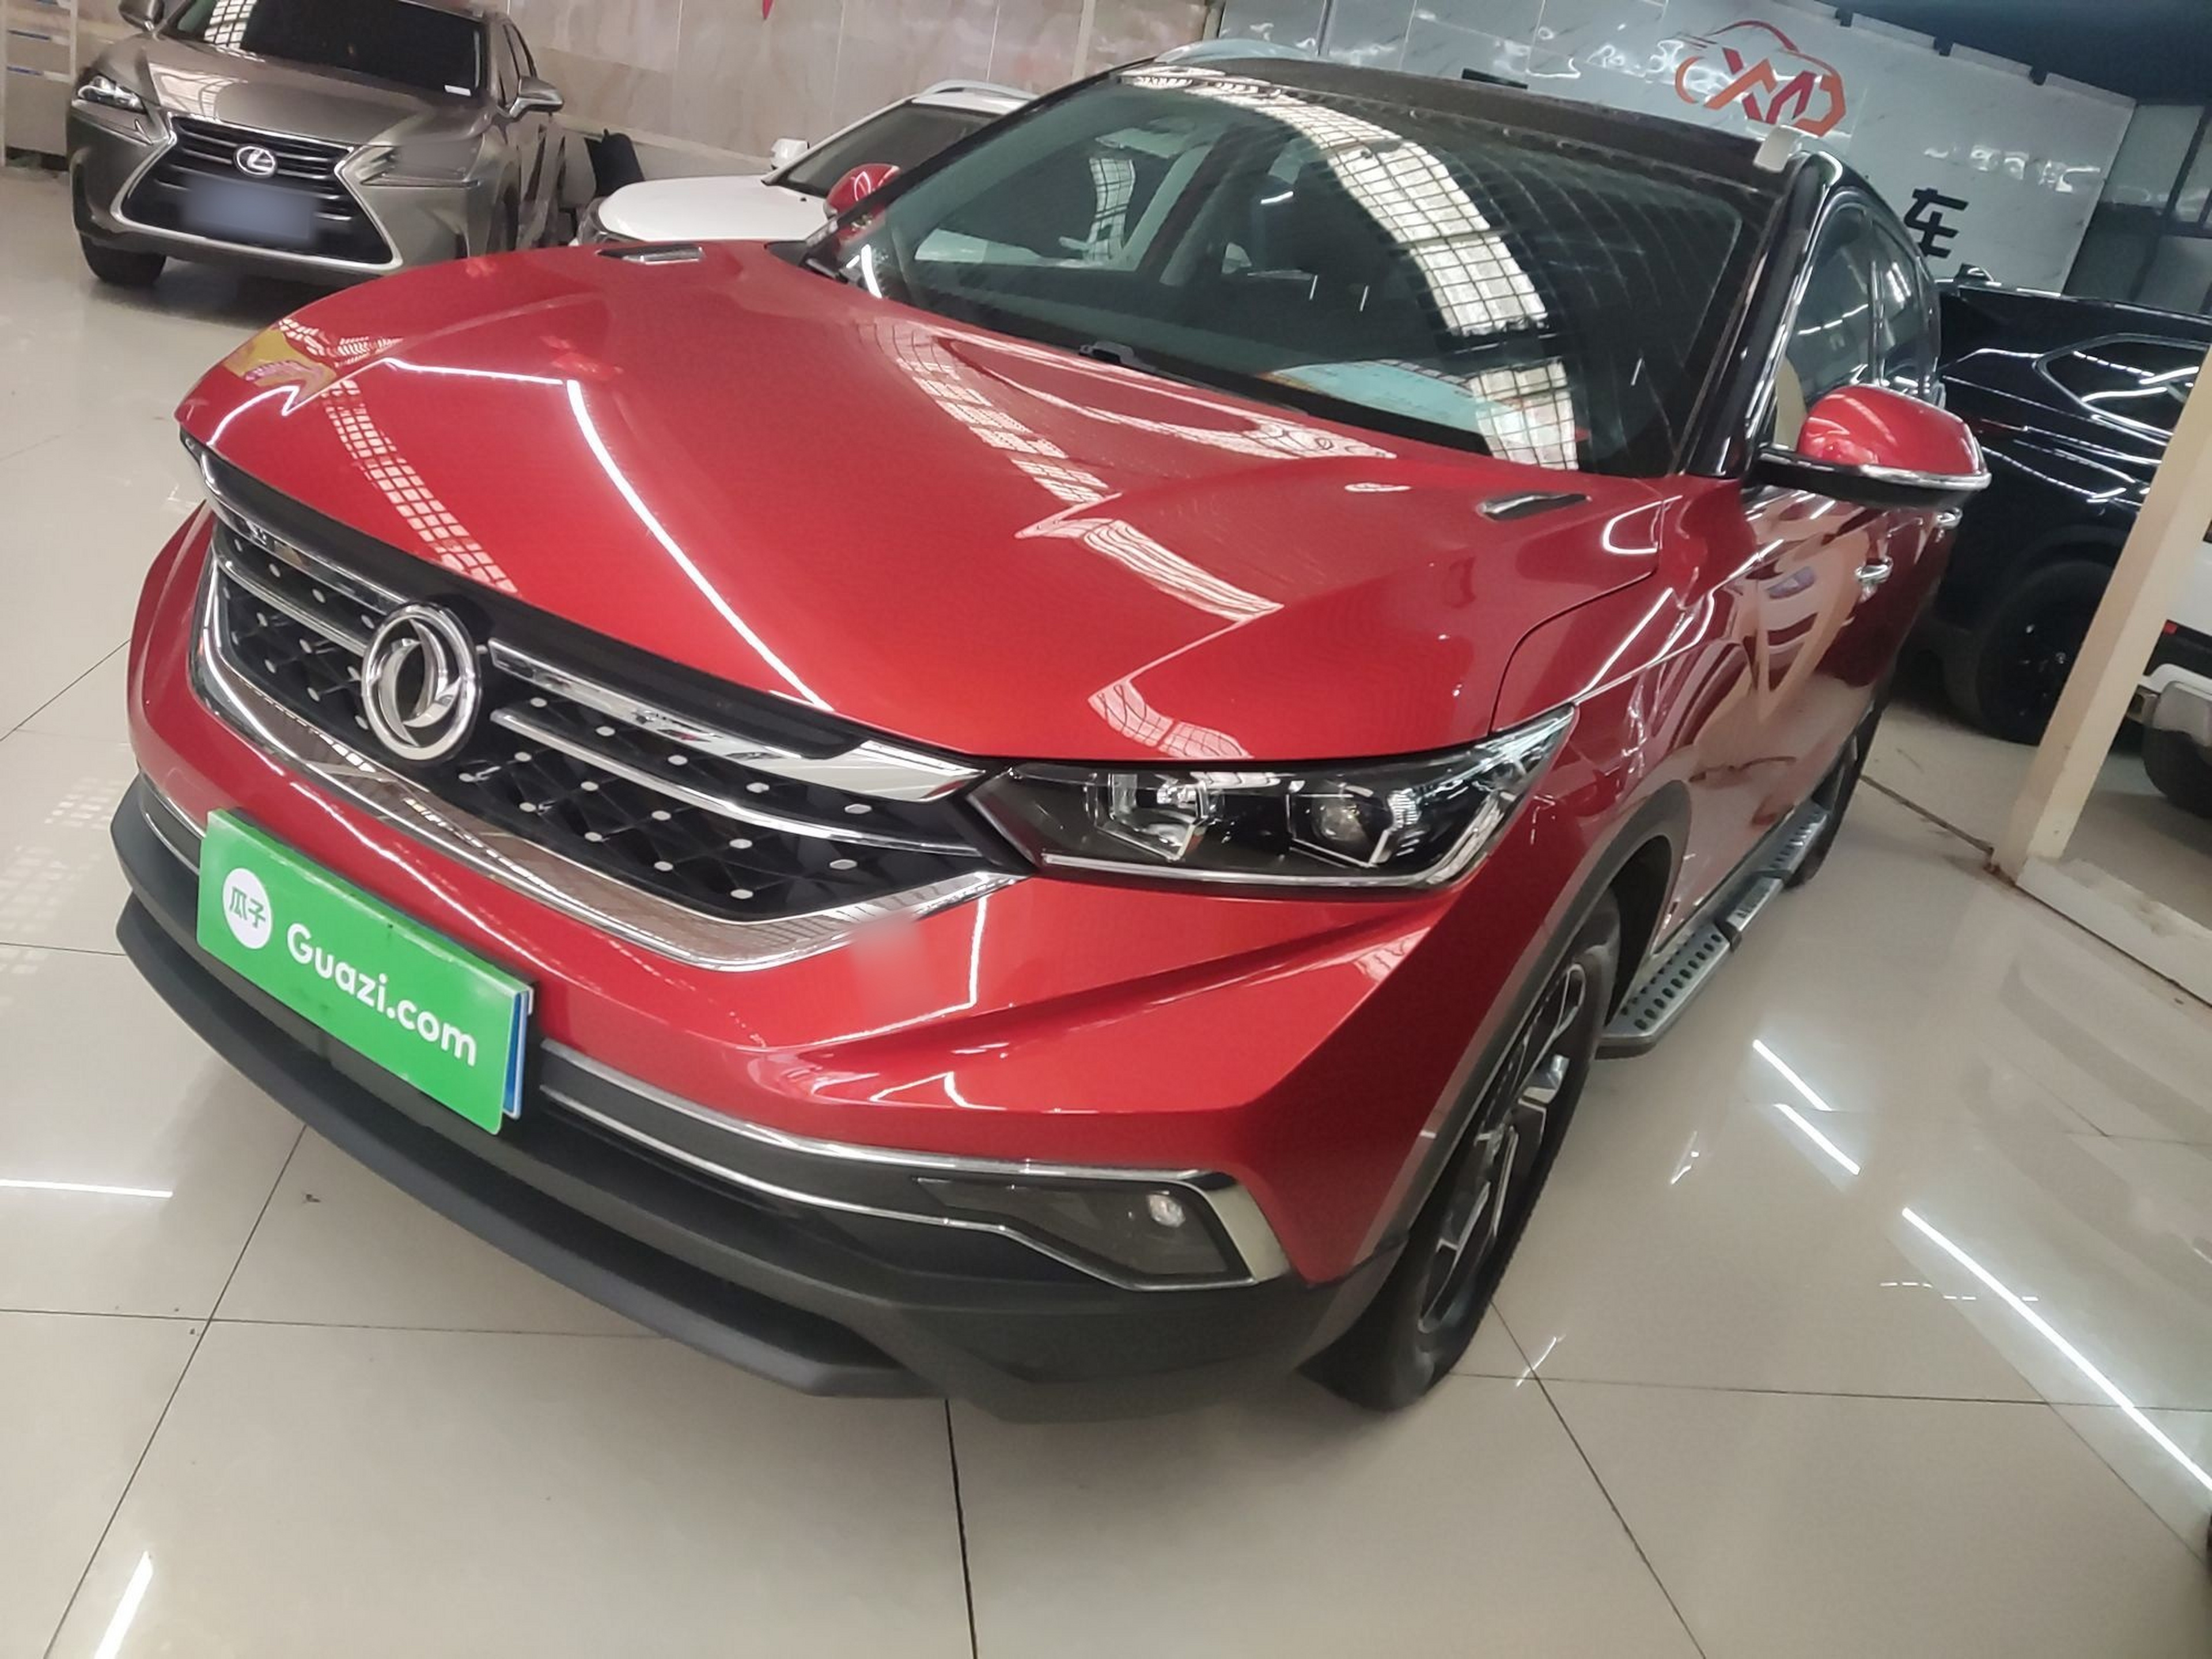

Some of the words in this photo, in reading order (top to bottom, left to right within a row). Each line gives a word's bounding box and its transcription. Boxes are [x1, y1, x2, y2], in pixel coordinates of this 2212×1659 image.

[1904, 187, 1969, 259] 车
[229, 886, 266, 929] 瓜子
[287, 923, 477, 1067] Guazi.com
